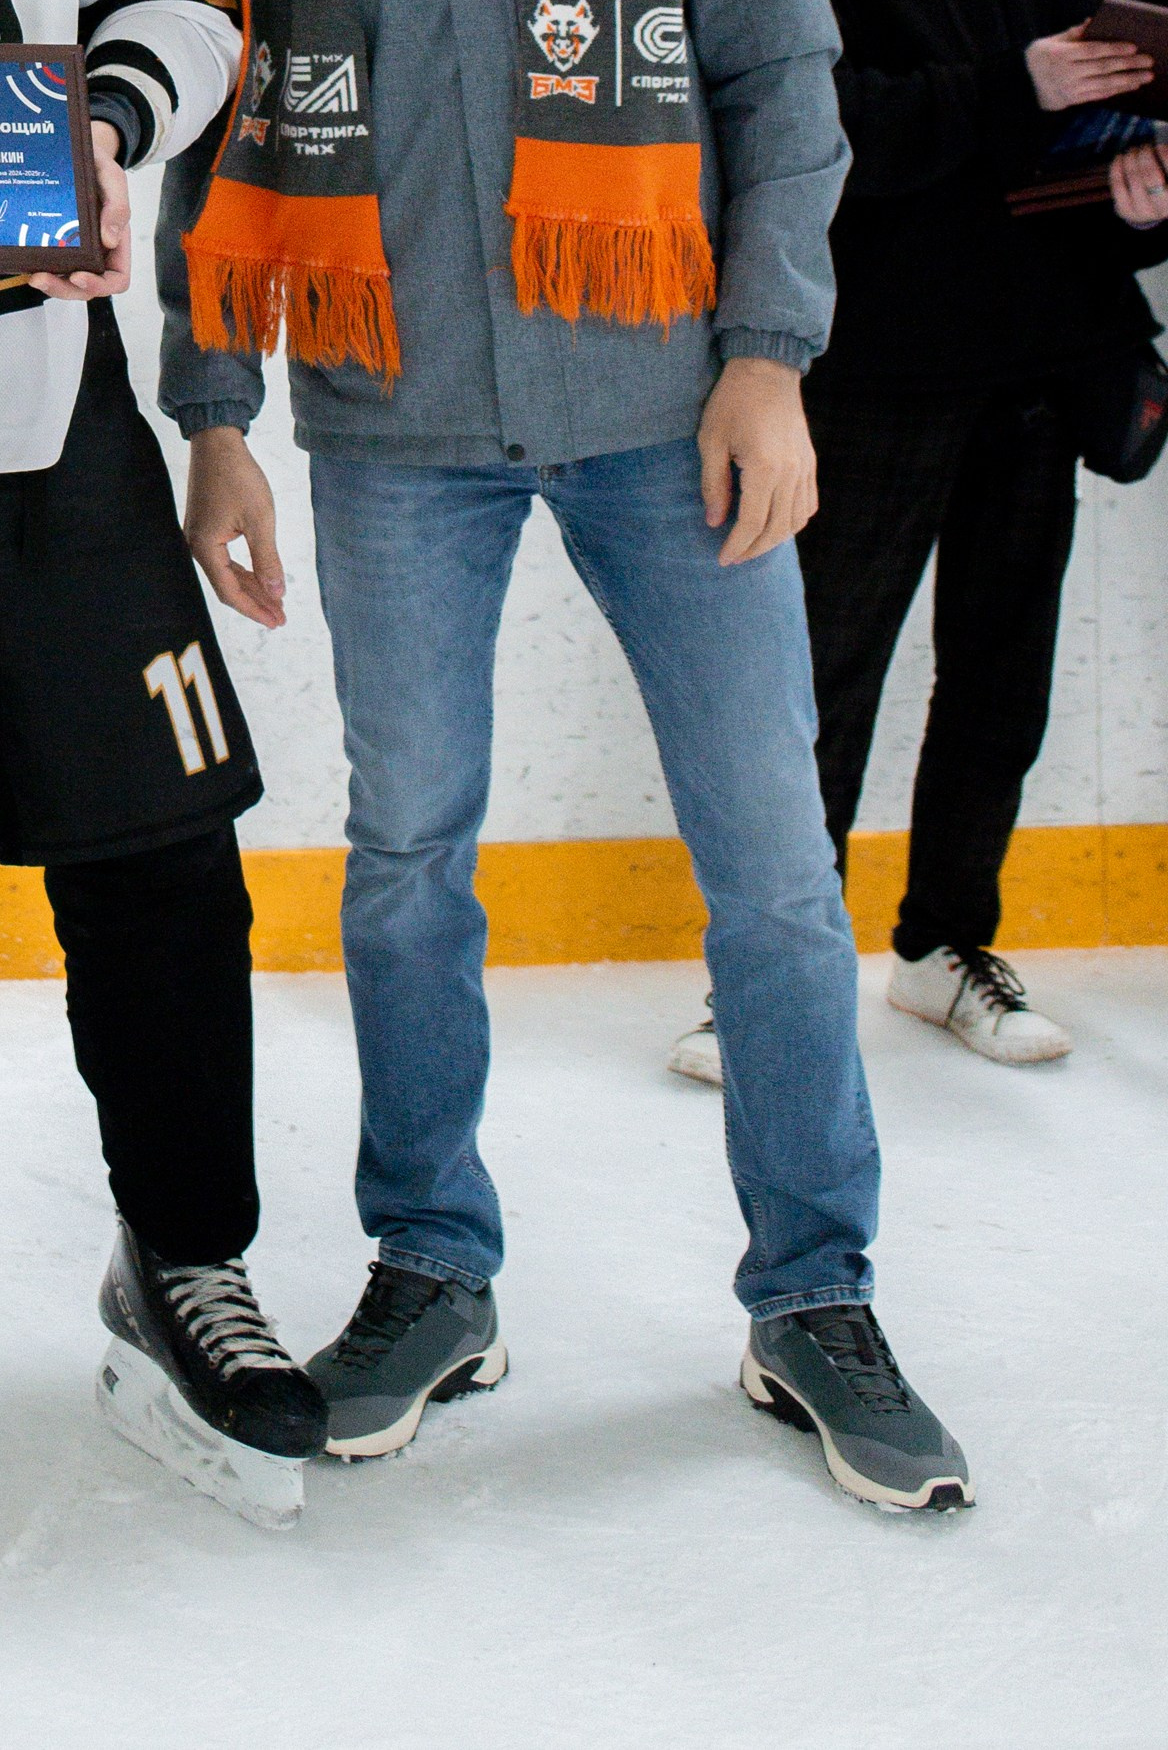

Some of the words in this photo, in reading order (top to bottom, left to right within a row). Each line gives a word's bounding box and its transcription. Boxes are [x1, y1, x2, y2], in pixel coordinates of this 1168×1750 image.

[527, 72, 600, 104] БМЗ
[294, 142, 336, 156] ТМХ
[142, 639, 230, 776] 11
